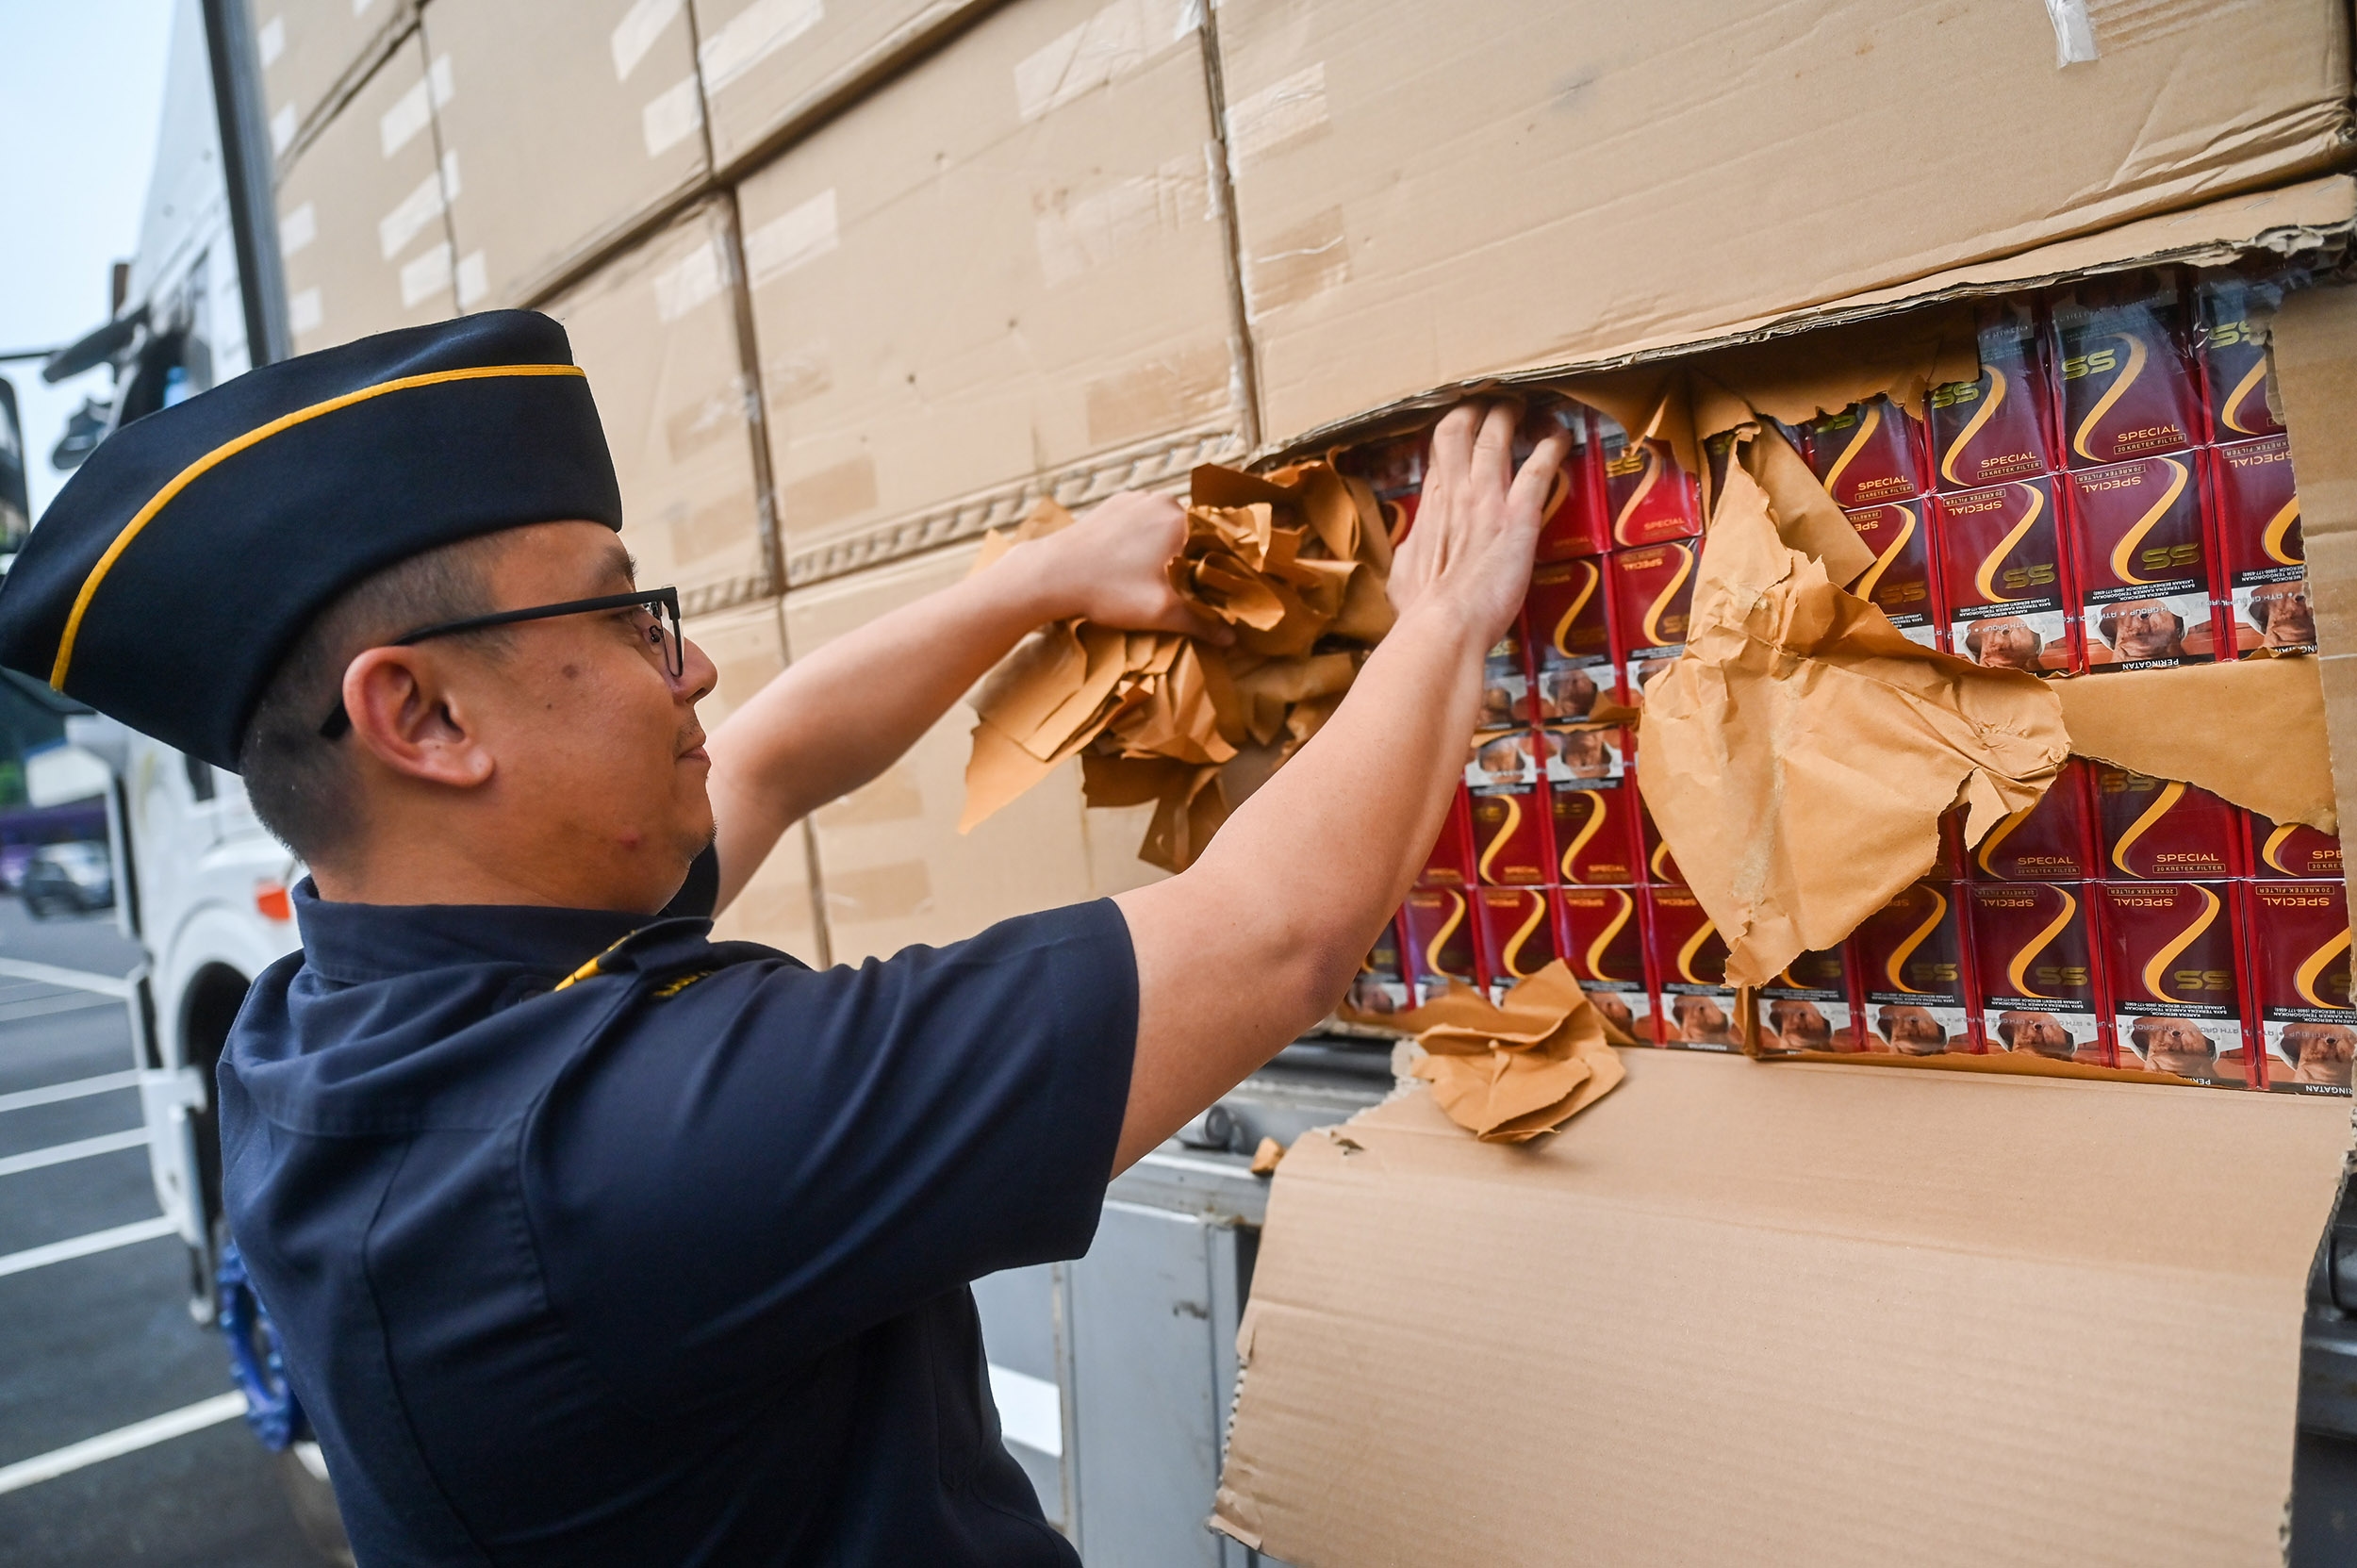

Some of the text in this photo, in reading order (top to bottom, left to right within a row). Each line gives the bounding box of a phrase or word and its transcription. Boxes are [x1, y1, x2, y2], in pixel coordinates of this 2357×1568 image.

[2061, 349, 2117, 381] SS
[1932, 383, 1979, 408] SS
[2118, 424, 2180, 442] SPECIAL
[2127, 440, 2155, 451] KRETEK
[2157, 436, 2184, 445] FILTER
[2226, 447, 2253, 456] FILTER
[1606, 454, 1644, 478] SS
[1981, 452, 2036, 469] SPECIAL
[2229, 451, 2293, 469] SPECIAL
[1988, 467, 2015, 477] KRETEK
[2017, 462, 2040, 471] FILTER
[2078, 472, 2102, 482] FILTER
[2104, 468, 2133, 477] KRETEK
[1857, 475, 1908, 491] SPECIAL
[2081, 476, 2142, 493] SPECIAL
[1866, 489, 1888, 499] KRETEK
[1889, 486, 1912, 494] FILTER
[1970, 492, 1995, 501] KRETEK
[1945, 496, 1968, 505] FILTER
[1948, 500, 2003, 516] SPECIAL
[1643, 518, 1686, 531] SPECIAL
[2141, 543, 2200, 570] SS
[2003, 563, 2055, 589] SS
[1880, 581, 1926, 604] SS
[2121, 657, 2180, 670] PERINGATAN
[2101, 773, 2155, 792] SS
[2018, 856, 2074, 866] SPECIAL
[2156, 852, 2219, 863] SPECIAL
[1980, 899, 2035, 907] SPECIAL
[2263, 898, 2330, 906] SPECIAL
[2036, 966, 2087, 985] SS
[2174, 970, 2232, 990] SS
[2305, 1085, 2353, 1094] RINGATAN
